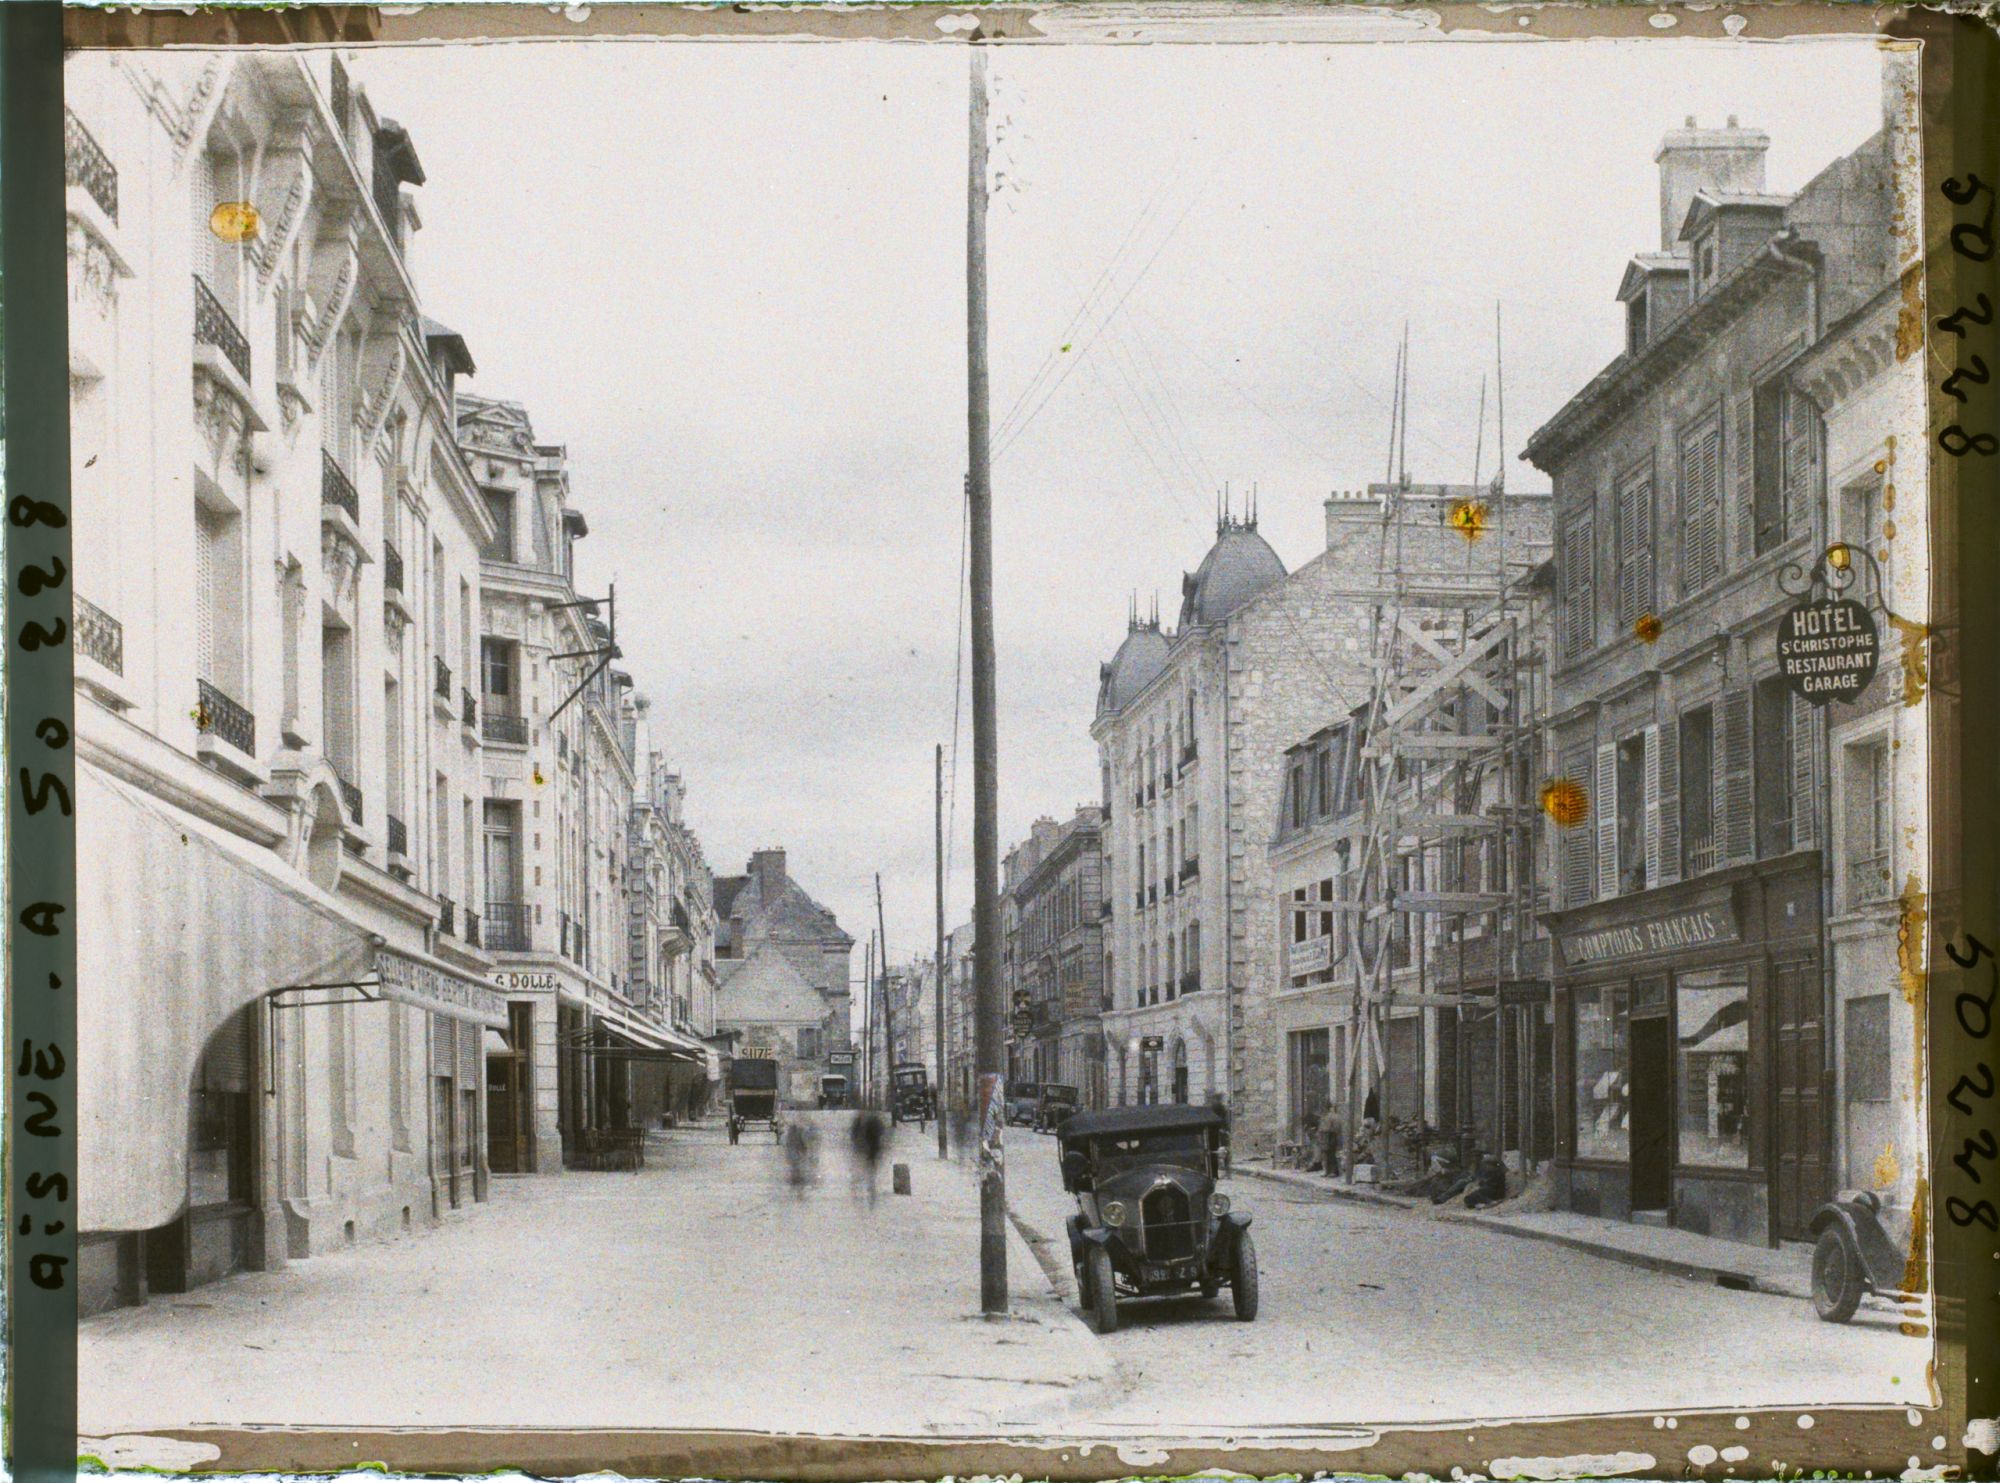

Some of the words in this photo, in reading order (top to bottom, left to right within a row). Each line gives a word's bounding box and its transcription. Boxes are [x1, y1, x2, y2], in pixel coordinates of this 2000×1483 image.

[1793, 633, 1873, 653] CHRISTOPHE
[1787, 652, 1872, 674] RESTAURANT
[1803, 673, 1859, 692] GARAGE
[1577, 926, 1644, 960] COMPTOIRS
